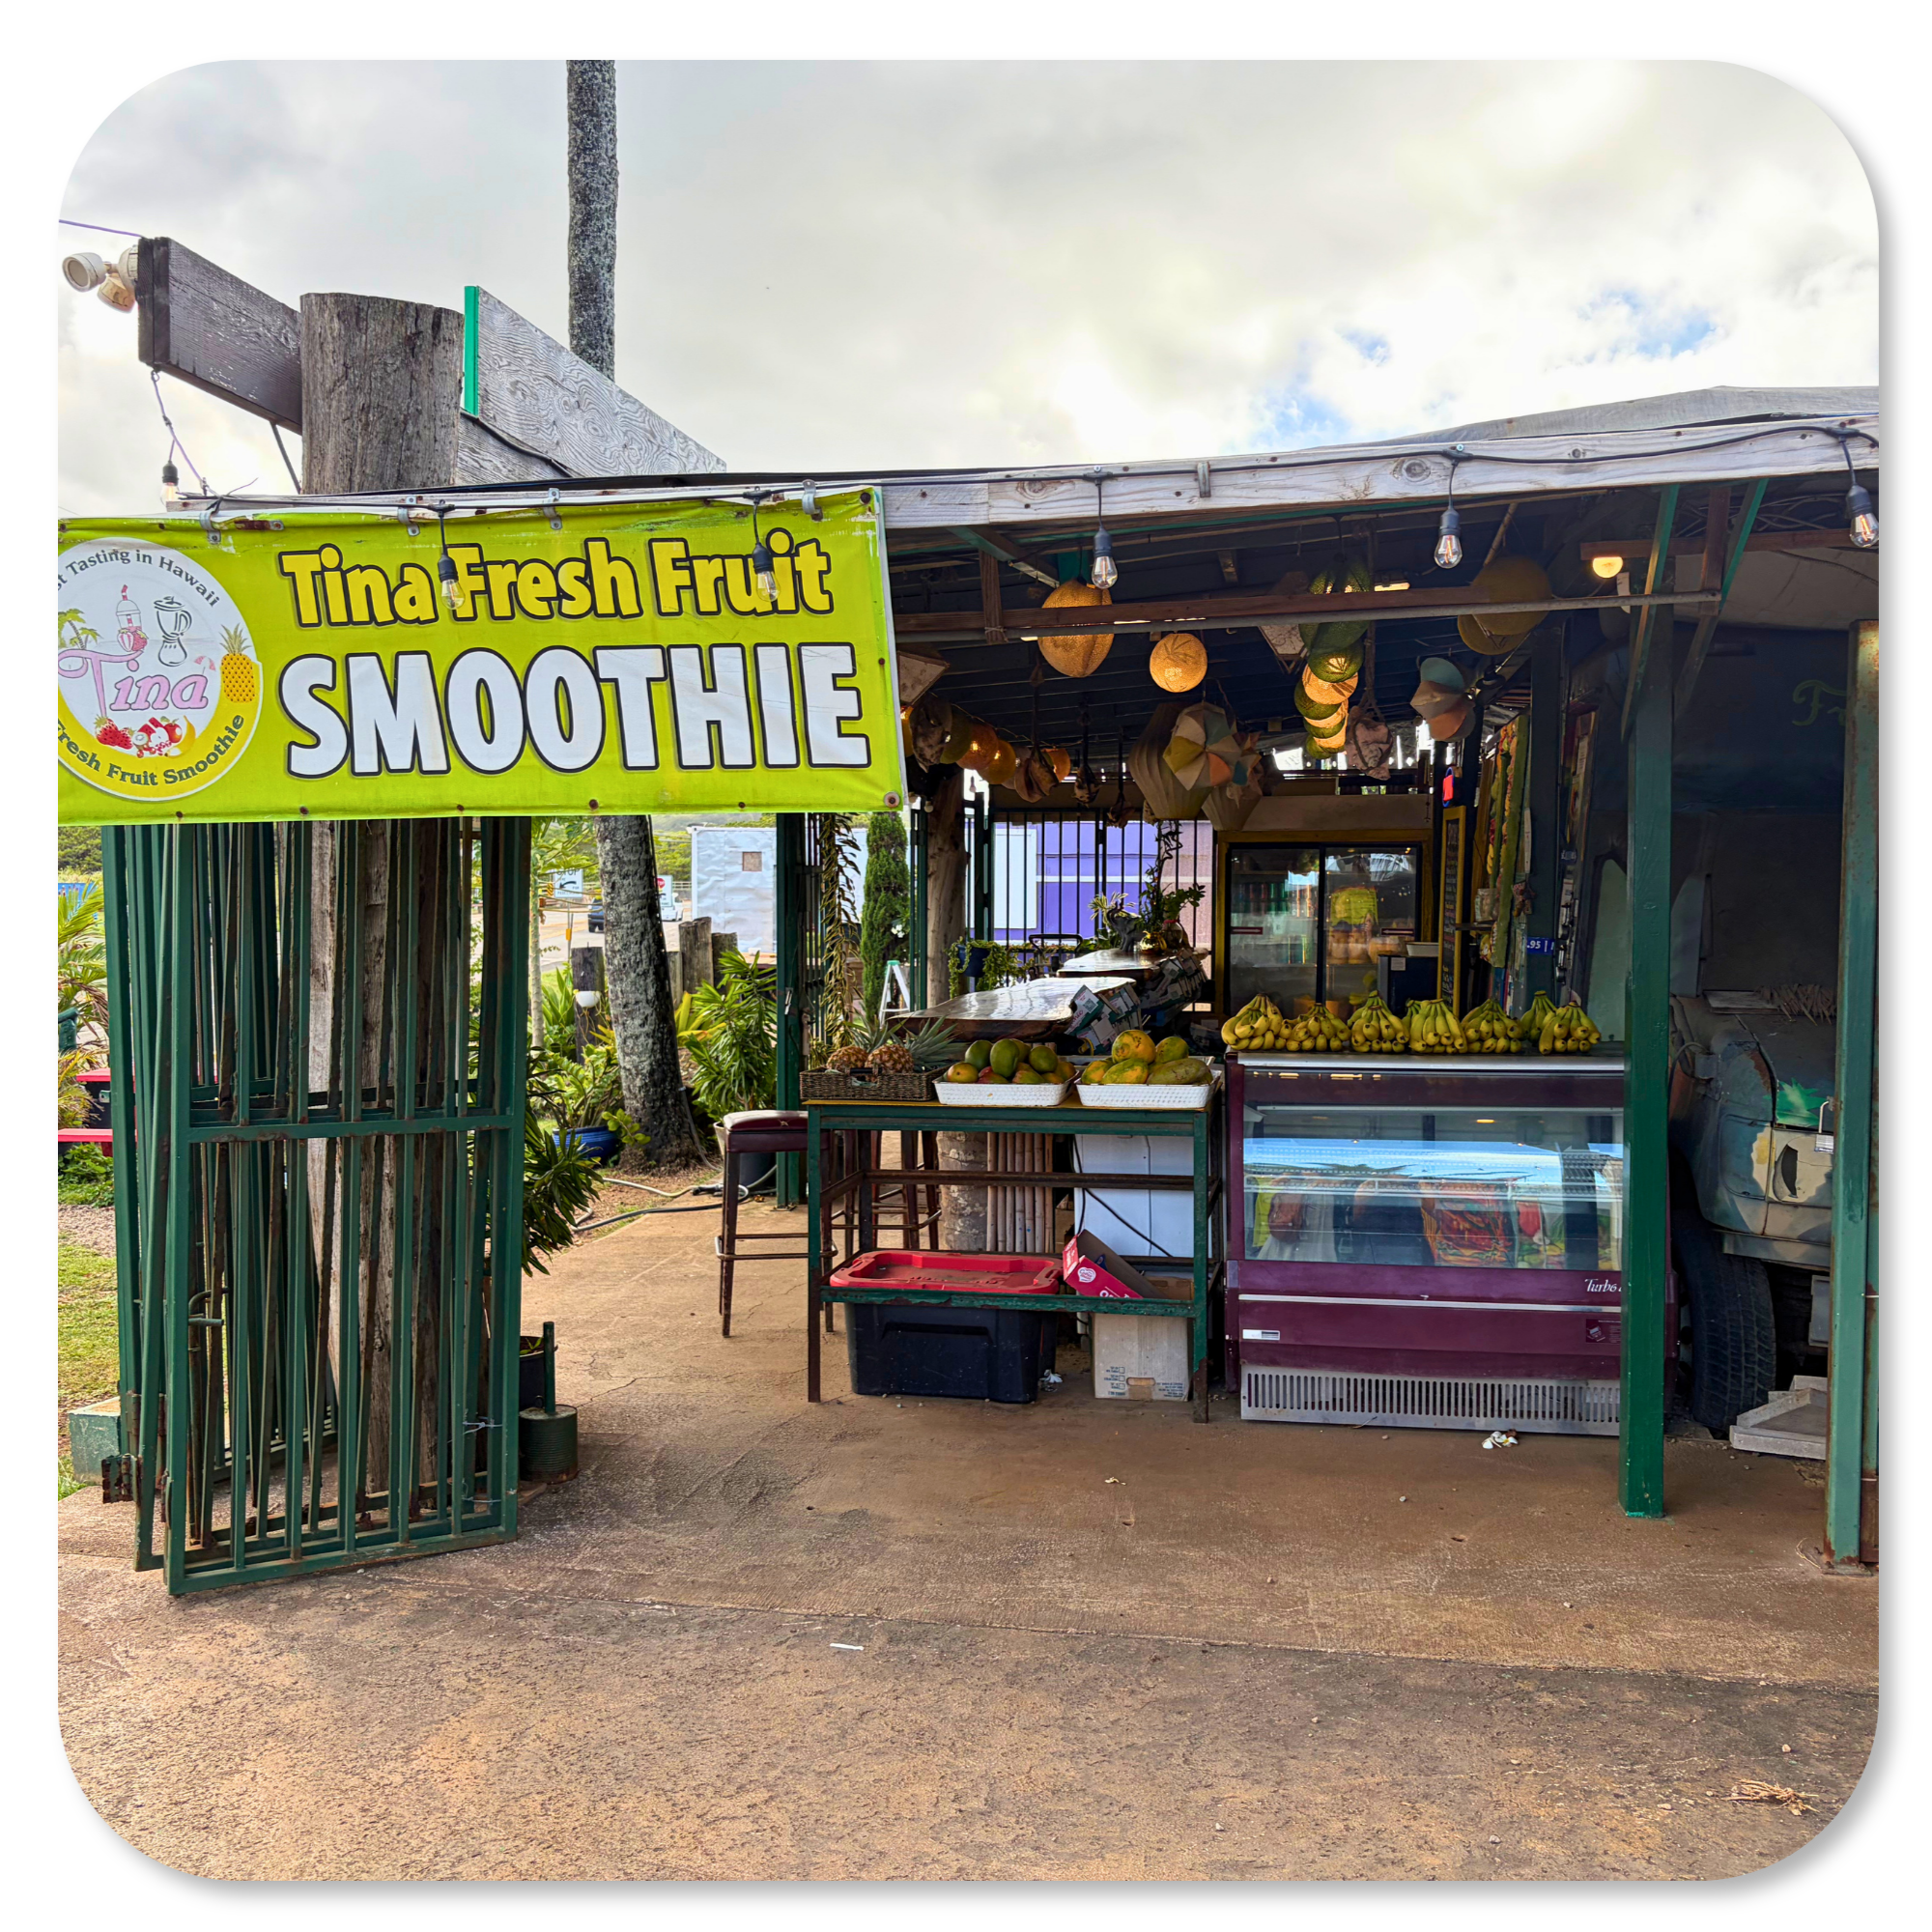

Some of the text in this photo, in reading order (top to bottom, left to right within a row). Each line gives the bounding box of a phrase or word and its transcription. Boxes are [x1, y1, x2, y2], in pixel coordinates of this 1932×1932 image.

[66, 549, 130, 576] Tasting
[135, 549, 153, 565] in
[158, 555, 220, 608] Hawaii
[278, 526, 834, 628] Tina Fresh Fruit
[58, 648, 209, 717] Tina
[278, 641, 871, 778] SMOOTHIE
[105, 762, 159, 786] Fruit
[163, 714, 245, 786] Smoothie
